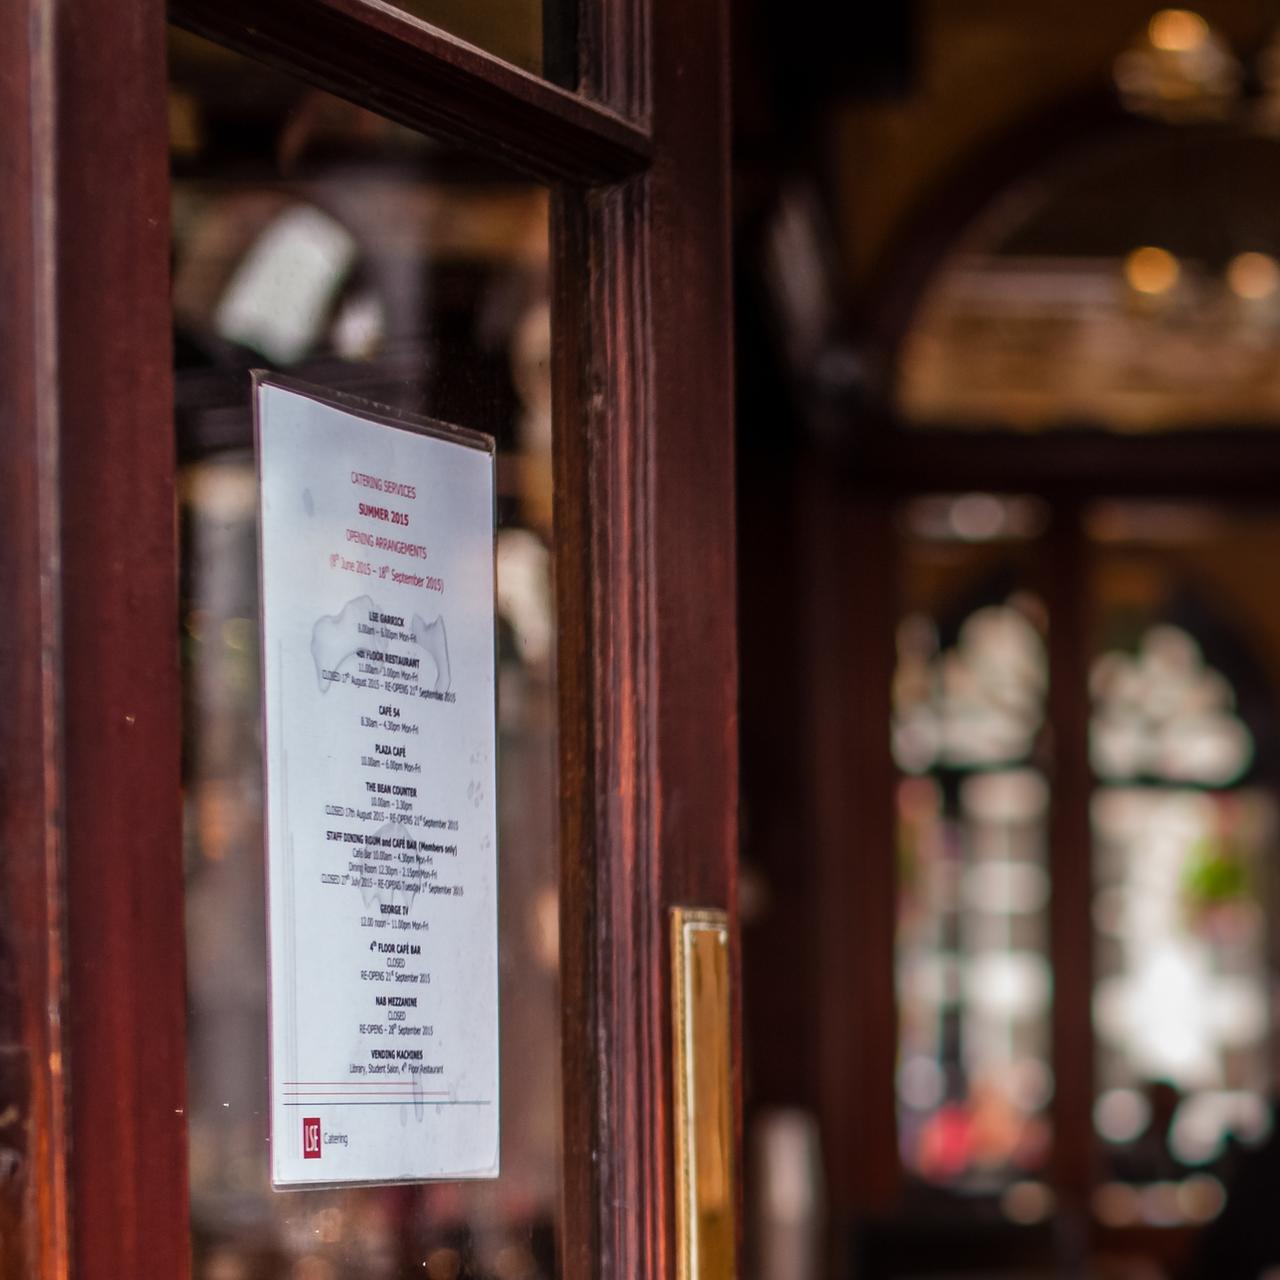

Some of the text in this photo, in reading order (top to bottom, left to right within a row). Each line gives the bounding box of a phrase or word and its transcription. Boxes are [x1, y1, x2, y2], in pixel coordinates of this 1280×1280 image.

[351, 471, 417, 499] CATERING SERVICES
[359, 503, 409, 526] SUMMER 2015
[346, 529, 428, 560] OPENING ARRANGEMENTS
[356, 561, 371, 576] 2015
[391, 569, 425, 587] September
[385, 653, 420, 669] RESTAURANT
[375, 744, 392, 755] PLAZA
[366, 782, 417, 797] THE BEAN COUNTER
[423, 816, 447, 829] September
[326, 830, 343, 841] STAFF
[380, 904, 402, 915] GEORGE
[378, 943, 395, 953] FLOOR
[410, 944, 421, 955] BAR
[387, 957, 406, 968] CLOSED
[395, 972, 418, 983] September
[388, 997, 417, 1008] MEZZANINE
[388, 1010, 406, 1021] CLOSED
[398, 1025, 421, 1036] September
[371, 1049, 423, 1060] VENDING MACHINES
[305, 1125, 348, 1152] LSE Catering
